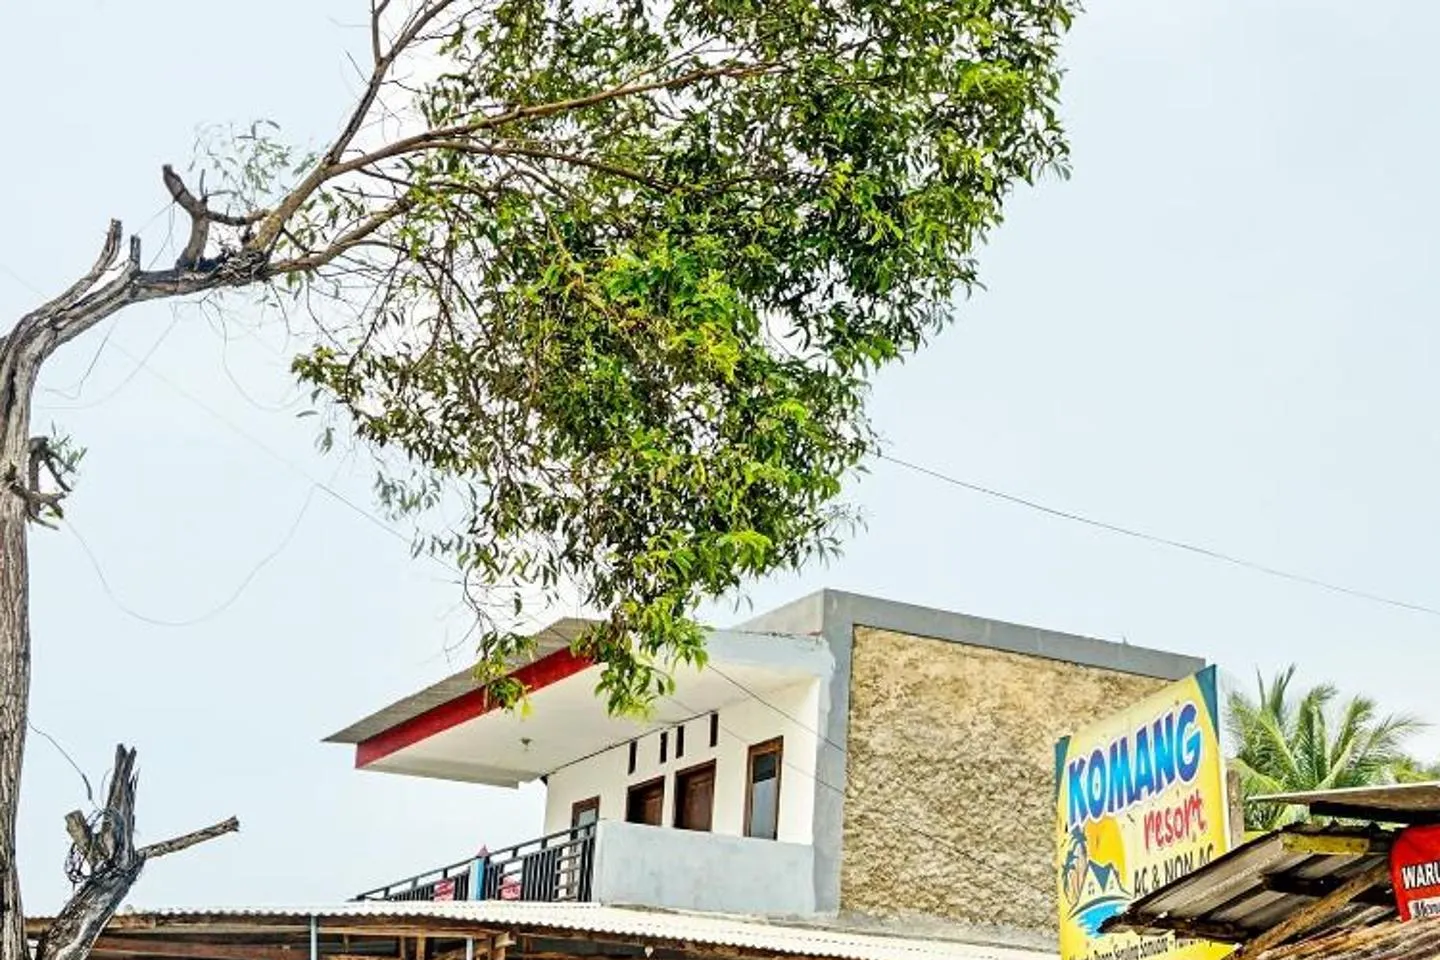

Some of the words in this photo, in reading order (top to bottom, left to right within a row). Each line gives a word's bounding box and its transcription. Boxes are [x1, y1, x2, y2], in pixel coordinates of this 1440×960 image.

[1067, 703, 1202, 824] KOMANG
[1143, 789, 1206, 851] resort
[1134, 867, 1148, 899] AC
[1164, 851, 1194, 885] NON
